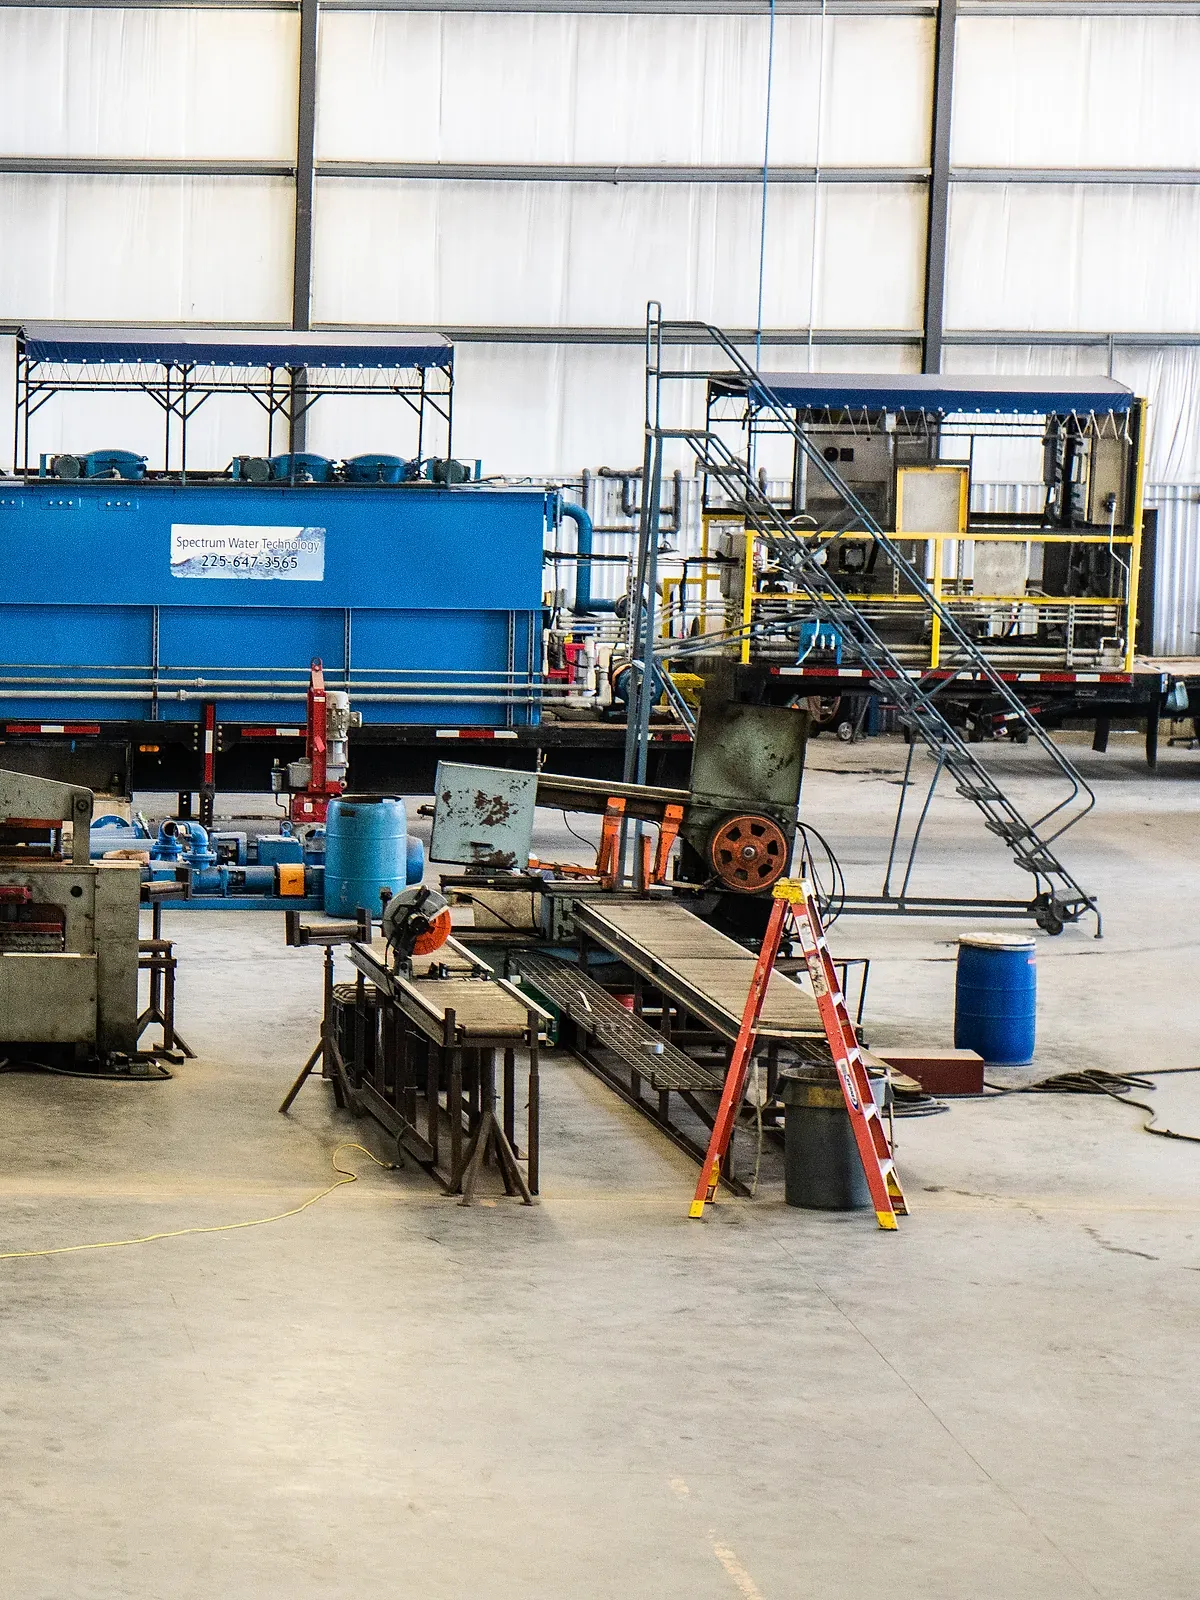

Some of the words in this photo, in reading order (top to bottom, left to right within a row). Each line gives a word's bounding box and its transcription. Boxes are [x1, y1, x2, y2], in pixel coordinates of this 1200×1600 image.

[176, 536, 226, 550] Spectrum
[228, 537, 259, 549] Water
[262, 538, 319, 553] Technology
[201, 555, 298, 569] 225-647-3565
